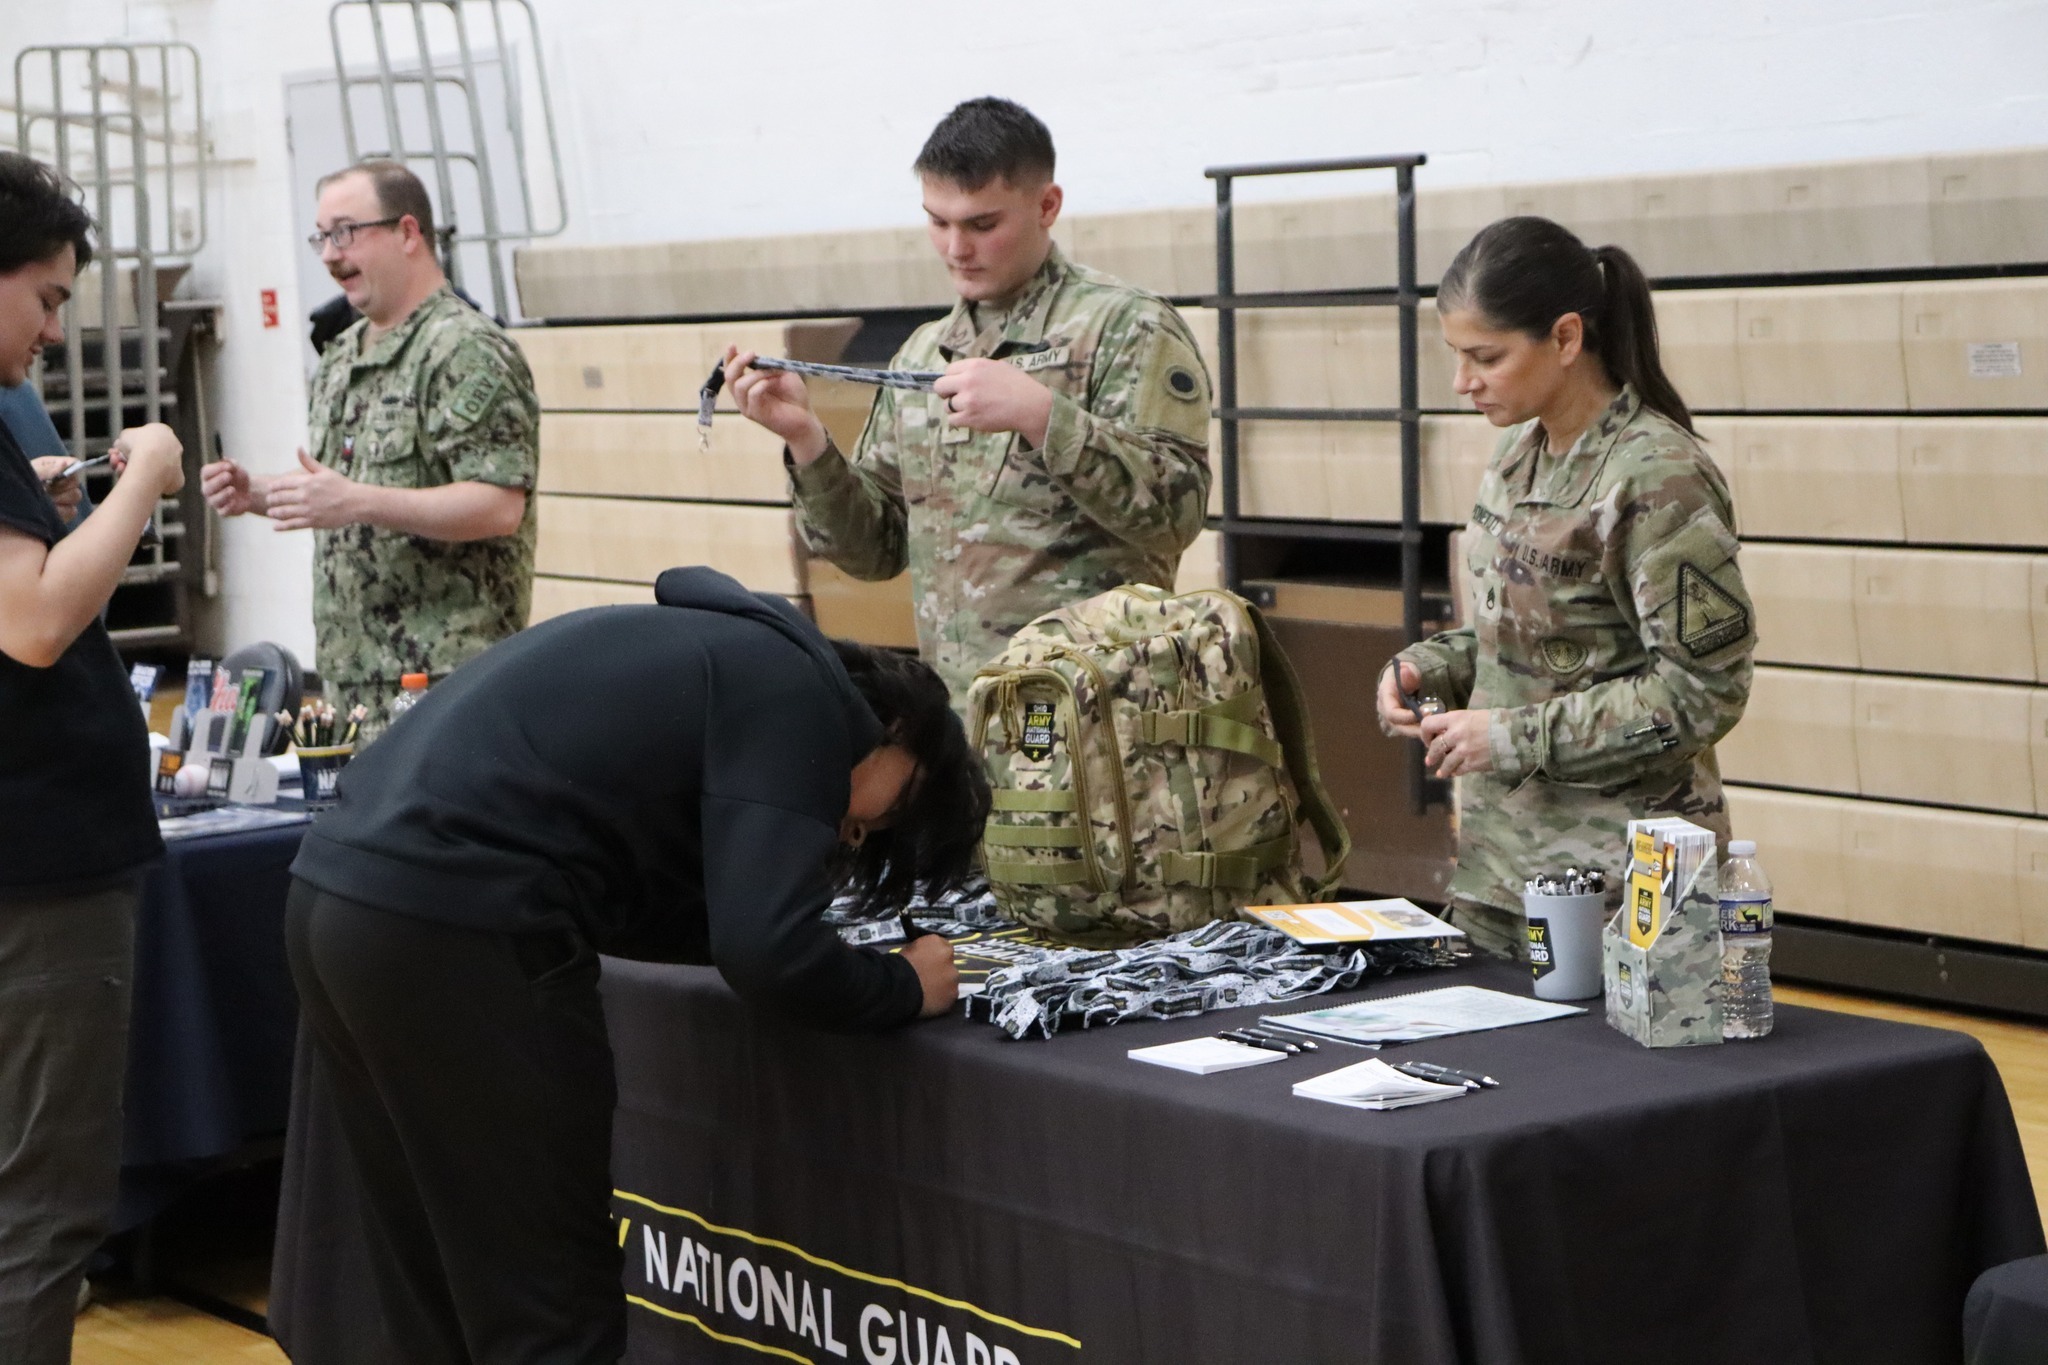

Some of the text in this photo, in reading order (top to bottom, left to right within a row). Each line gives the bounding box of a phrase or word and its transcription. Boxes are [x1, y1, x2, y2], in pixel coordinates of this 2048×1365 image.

[1029, 349, 1060, 367] ARMY
[1522, 544, 1586, 579] U.S. ARMY
[1033, 704, 1047, 713] OHIO
[1027, 715, 1051, 726] ARMY
[1025, 733, 1050, 744] GUARD
[1528, 929, 1544, 942] MY
[1530, 950, 1549, 962] ARD
[643, 1224, 847, 1358] NATIONAL
